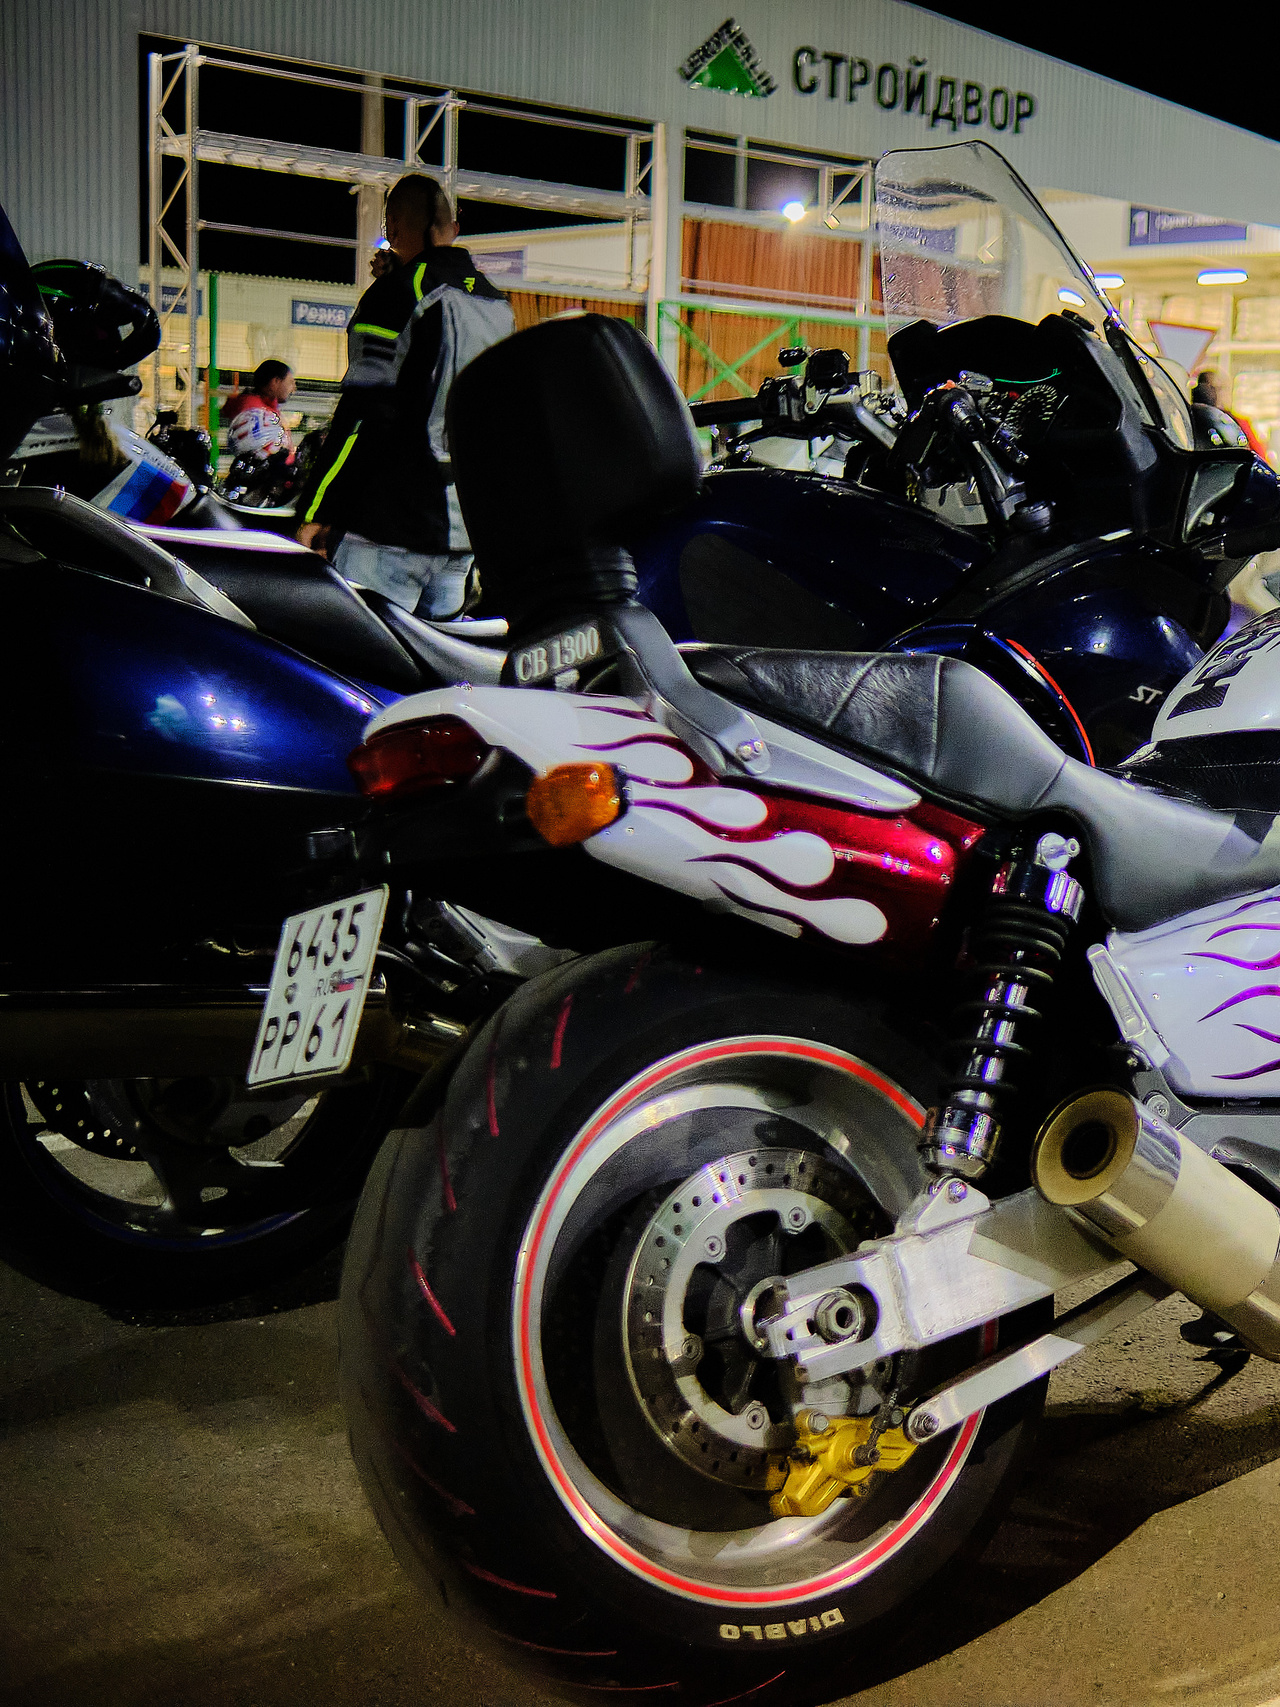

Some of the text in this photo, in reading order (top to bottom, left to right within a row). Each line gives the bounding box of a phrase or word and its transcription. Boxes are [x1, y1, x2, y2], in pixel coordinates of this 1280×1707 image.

[792, 45, 1036, 135] СТРОЙДВОР
[1132, 210, 1149, 237] 1
[551, 626, 600, 669] 1300
[287, 902, 367, 977] 6435
[304, 999, 351, 1062] 61
[719, 1607, 845, 1640] DIABLO
